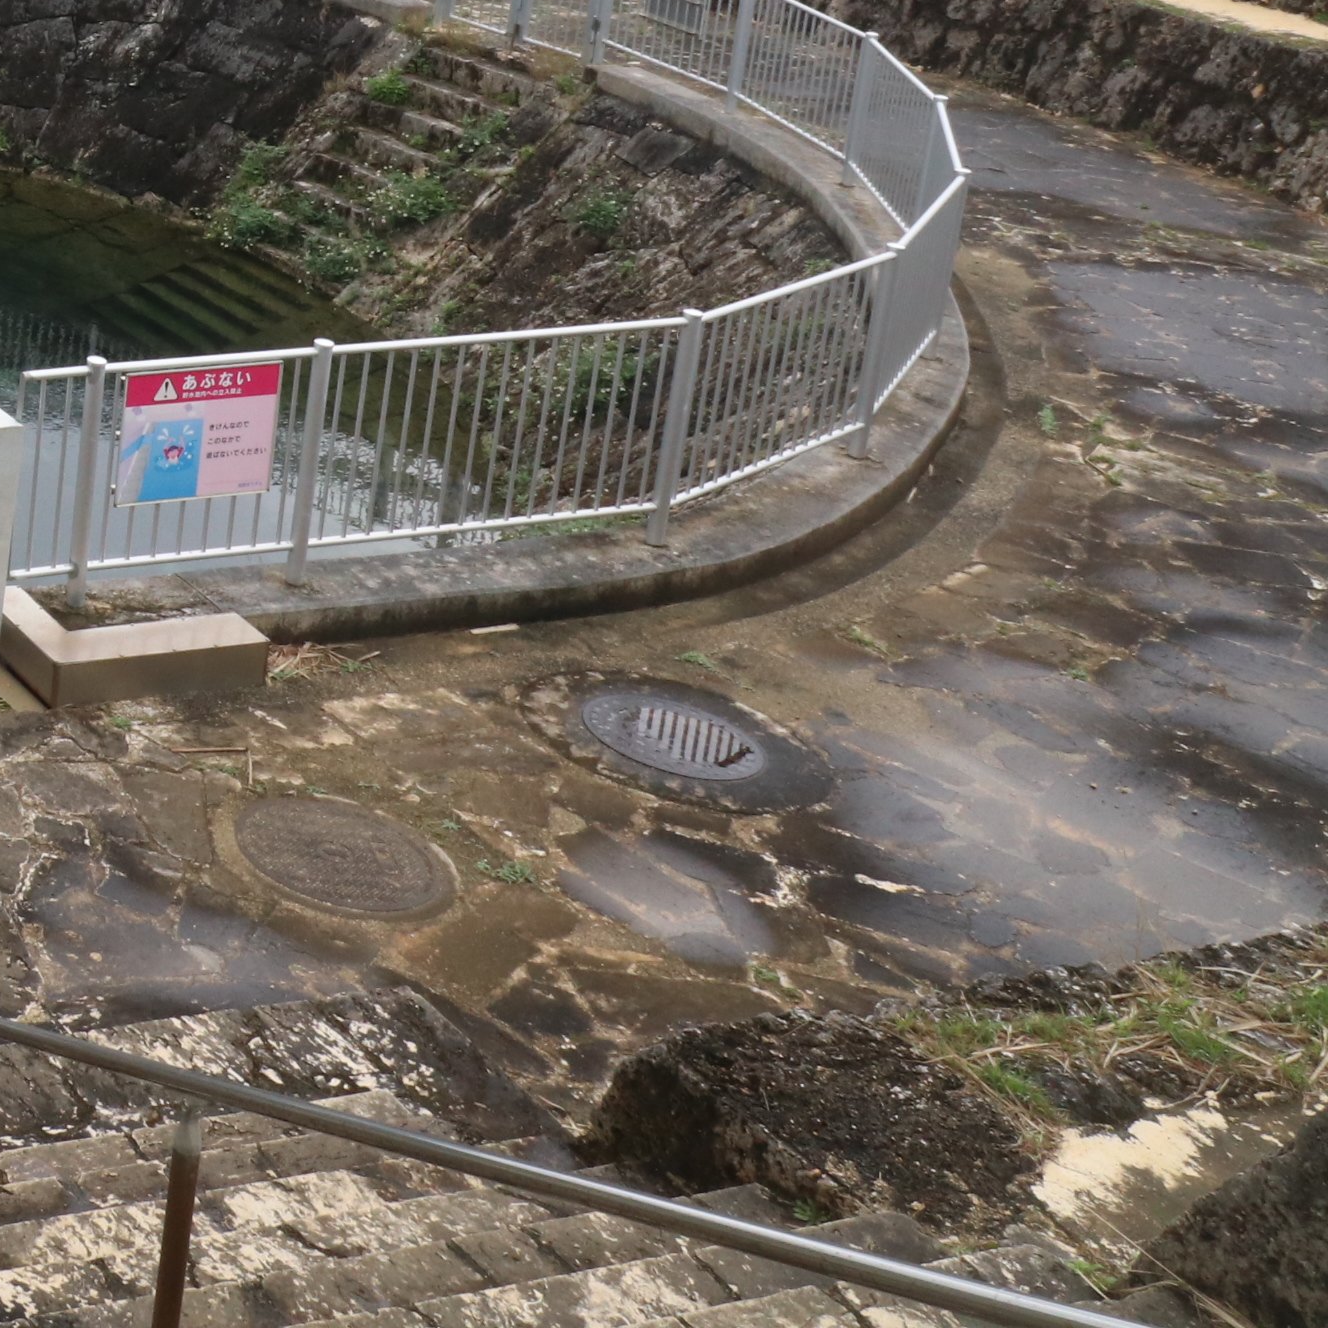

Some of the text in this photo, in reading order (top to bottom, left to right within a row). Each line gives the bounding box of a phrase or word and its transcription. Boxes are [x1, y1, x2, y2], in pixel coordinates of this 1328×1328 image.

[182, 371, 251, 390] あぶない
[209, 421, 250, 431] きけんなので
[207, 436, 241, 445] このなかで
[206, 448, 267, 459] 遊ばないでください
